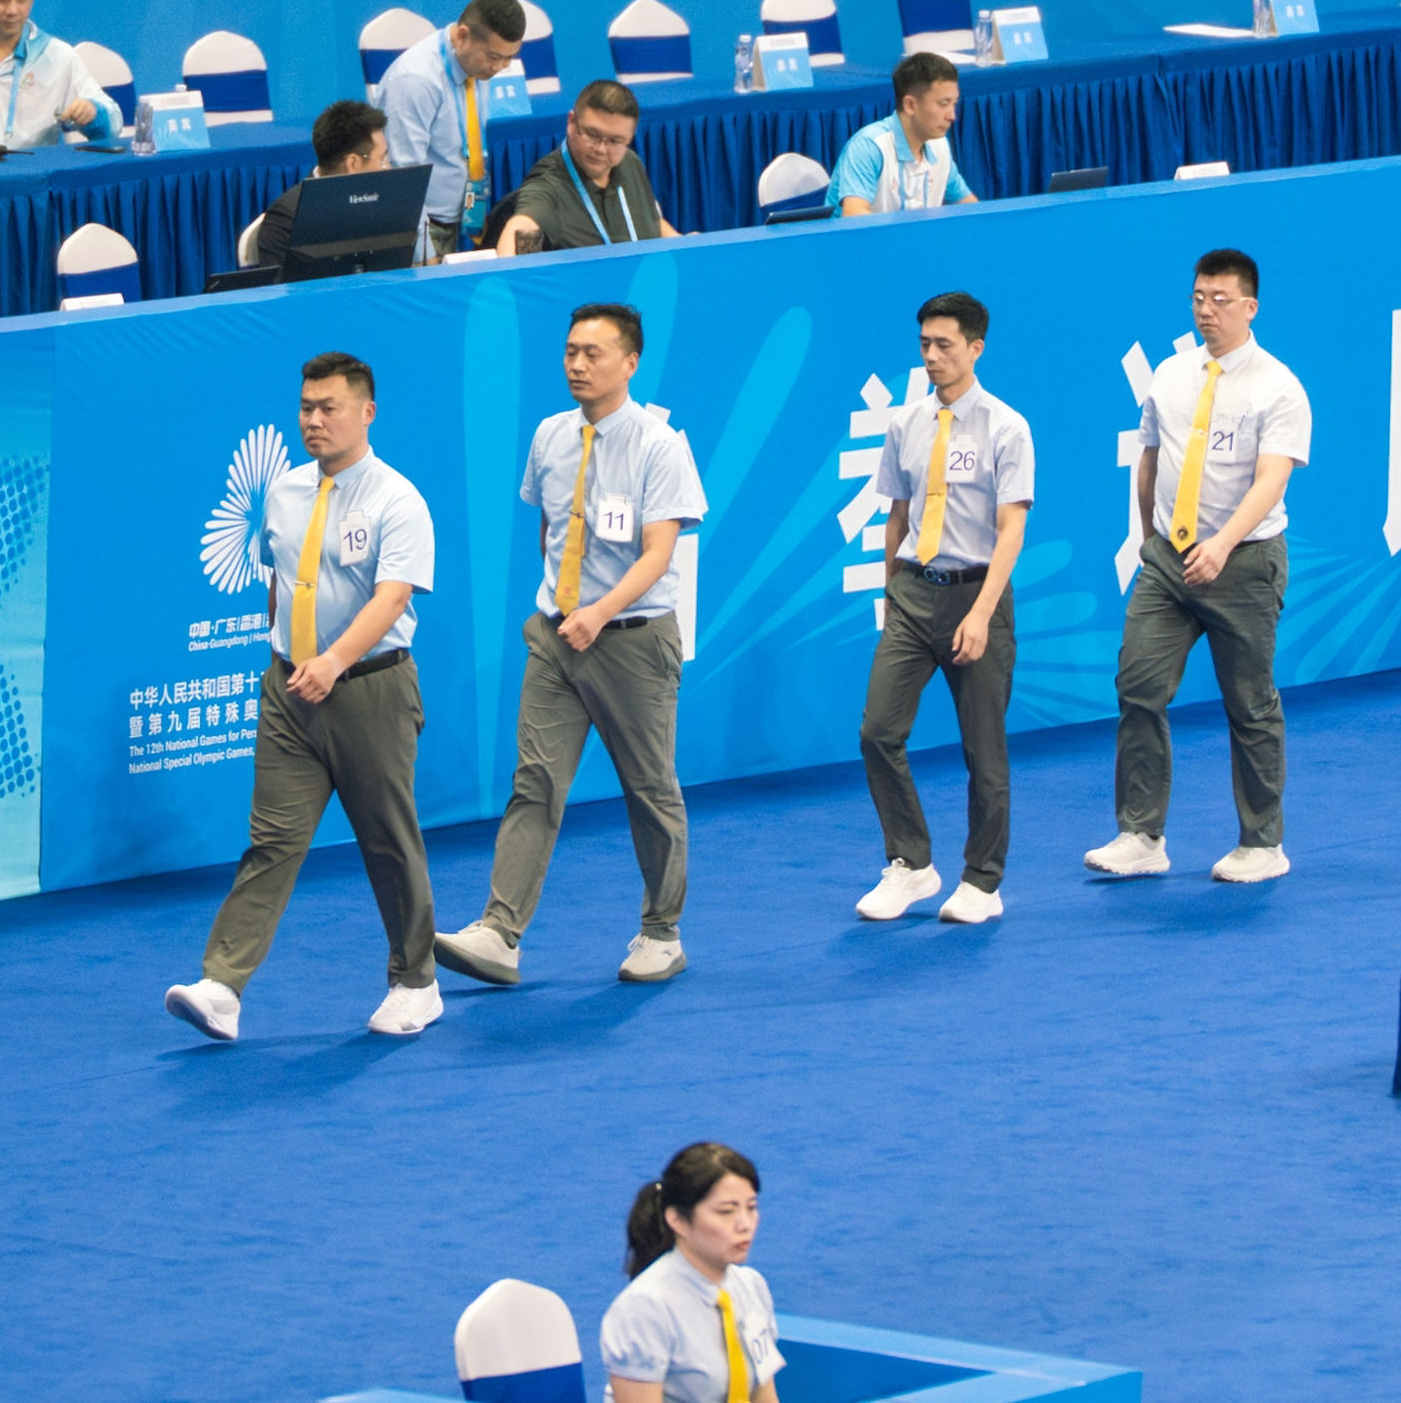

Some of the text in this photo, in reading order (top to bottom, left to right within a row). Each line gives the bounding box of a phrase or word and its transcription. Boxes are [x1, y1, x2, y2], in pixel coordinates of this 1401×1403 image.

[1212, 431, 1234, 451] 21
[949, 451, 975, 471] 26
[605, 512, 624, 530] 11
[343, 529, 367, 552] 19
[130, 671, 264, 710] 中华人民共和国第十
[129, 745, 144, 757] The
[165, 736, 198, 752] National
[199, 733, 227, 747] Games
[228, 729, 239, 742] for
[129, 759, 161, 774] National
[163, 755, 192, 770] Special
[193, 750, 224, 767] Olympic
